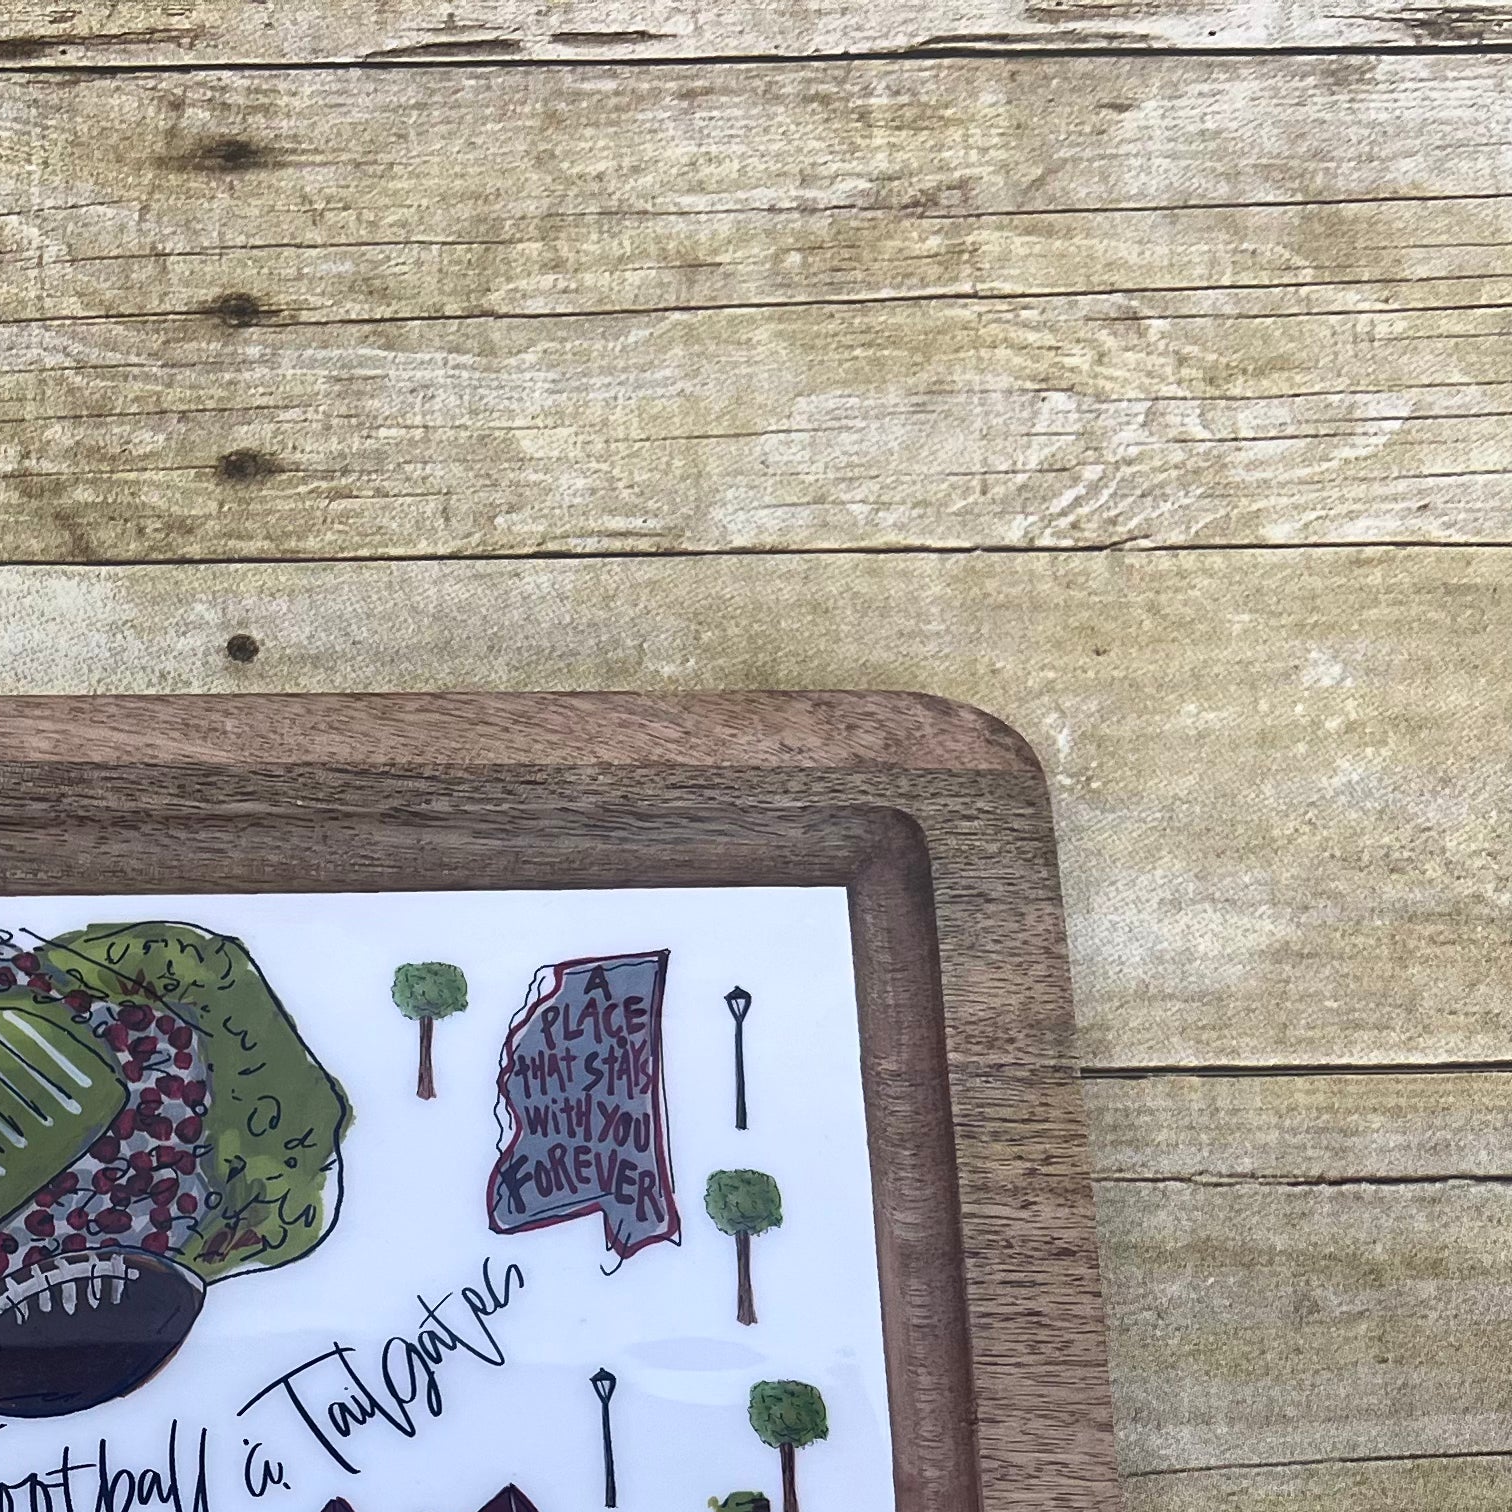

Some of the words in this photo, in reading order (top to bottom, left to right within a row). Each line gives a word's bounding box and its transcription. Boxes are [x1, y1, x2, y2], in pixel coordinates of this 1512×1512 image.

[540, 996, 648, 1051] PLACE
[500, 1142, 666, 1224] FOREVER
[237, 1256, 526, 1474] Tailgates
